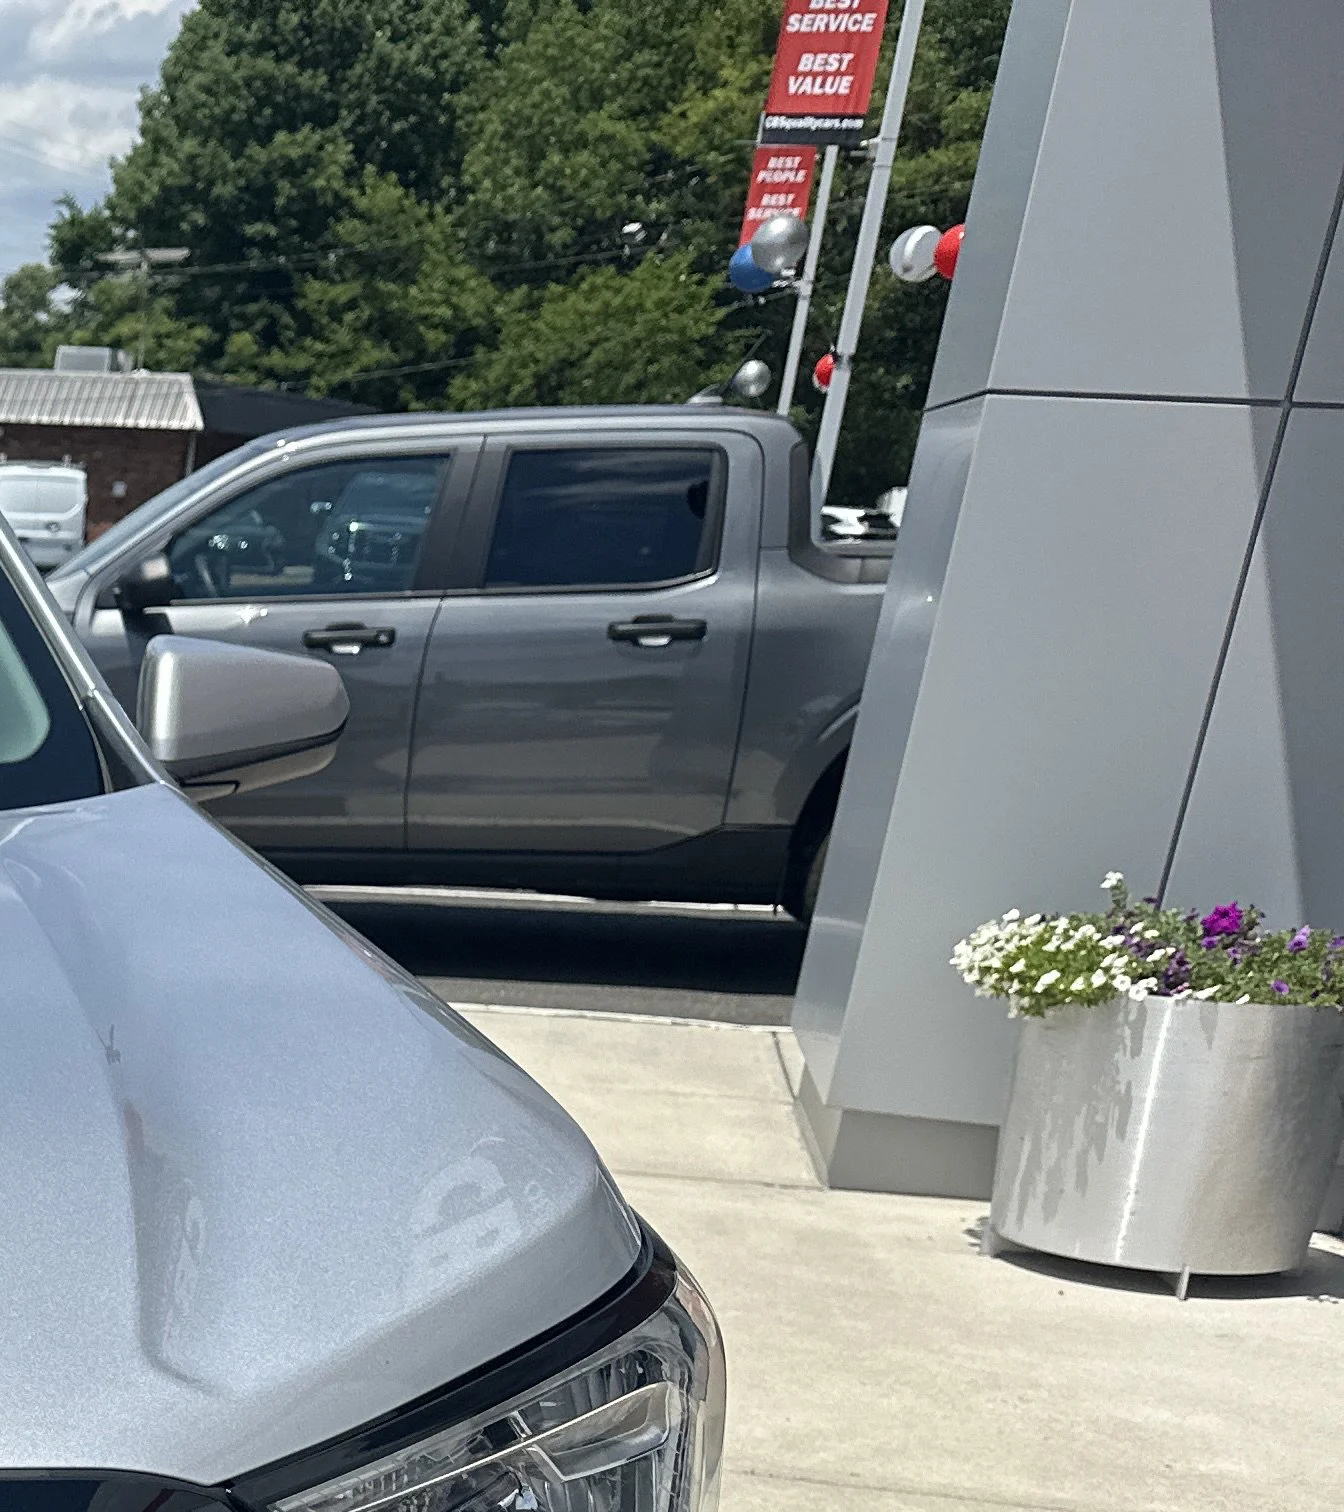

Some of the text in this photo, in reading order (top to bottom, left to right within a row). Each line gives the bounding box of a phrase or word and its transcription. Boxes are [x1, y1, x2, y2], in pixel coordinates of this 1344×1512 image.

[786, 13, 877, 33] SERVICE
[797, 53, 855, 72] BEST
[788, 75, 854, 96] VALUE
[767, 157, 802, 169] BEST
[756, 170, 808, 184] PEOPLE
